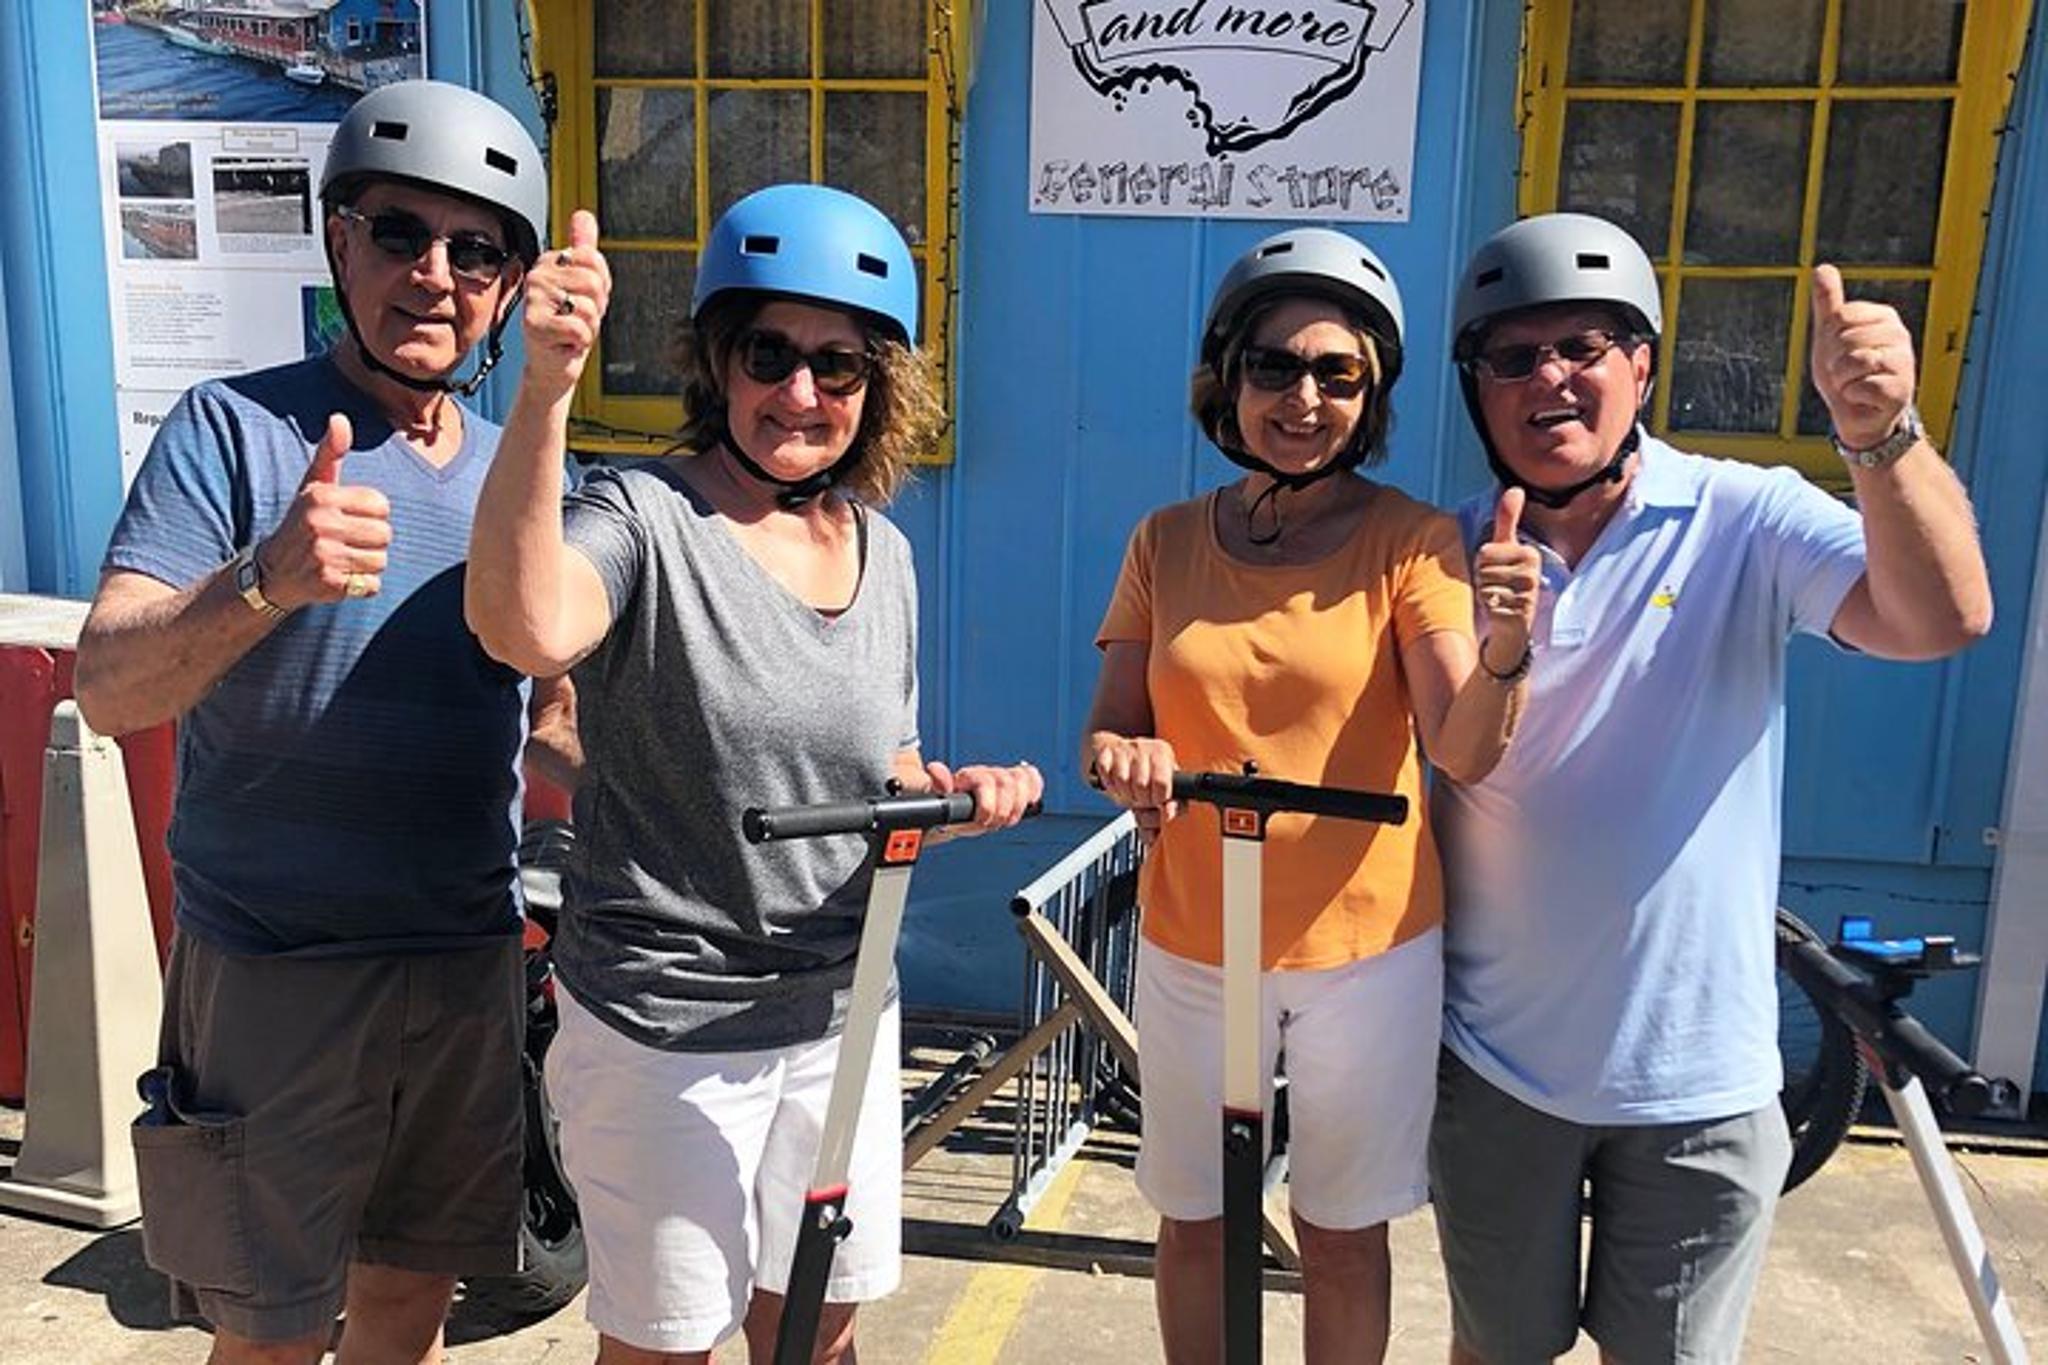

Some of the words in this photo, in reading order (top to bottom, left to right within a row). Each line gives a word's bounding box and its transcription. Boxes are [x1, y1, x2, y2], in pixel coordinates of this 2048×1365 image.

[1100, 0, 1203, 46] and
[1215, 5, 1354, 46] more
[1040, 160, 1235, 209] General
[1246, 163, 1400, 211] Store
